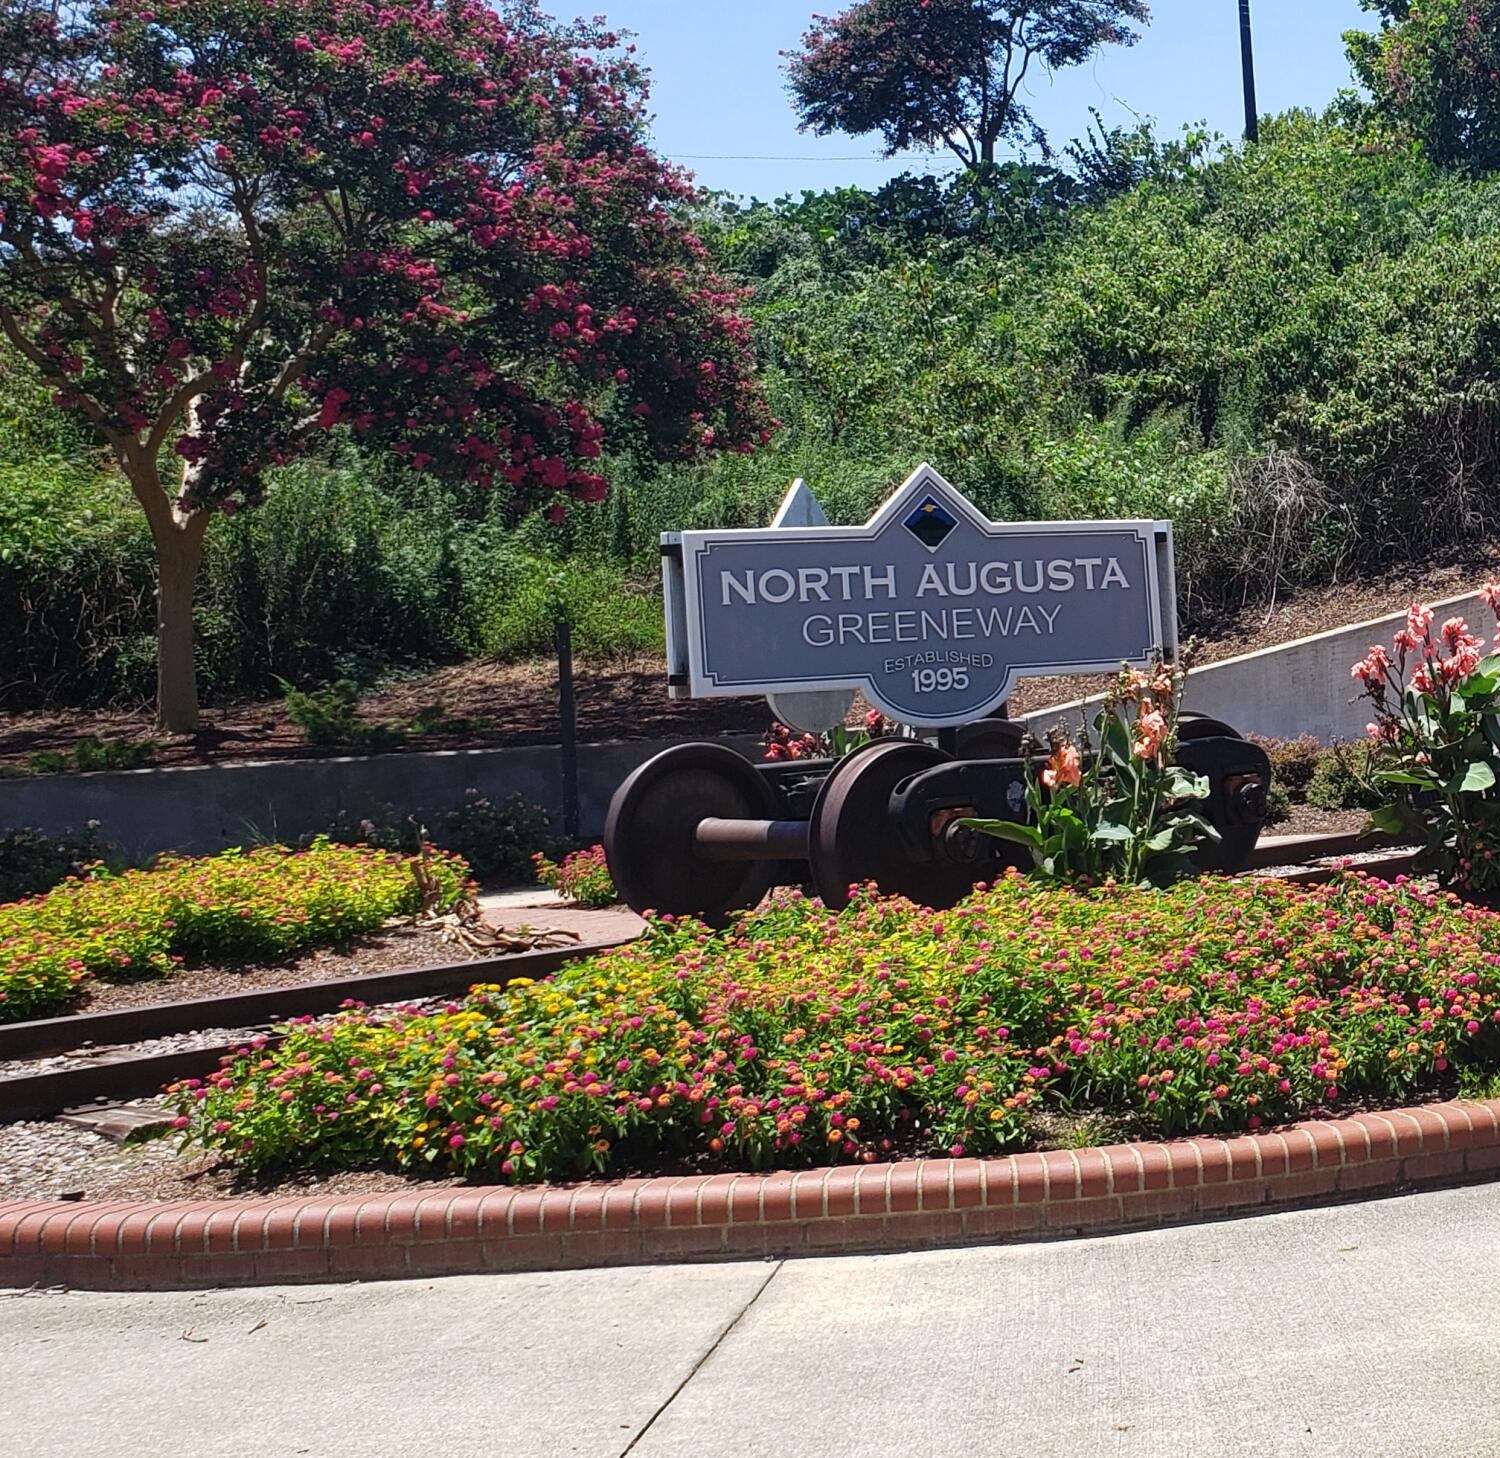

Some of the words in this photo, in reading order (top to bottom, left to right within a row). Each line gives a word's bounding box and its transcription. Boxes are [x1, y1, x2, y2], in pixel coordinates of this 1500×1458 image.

[720, 564, 897, 606] NORTH
[915, 556, 1131, 599] AUGUSTA
[801, 603, 1063, 647] GREENEWAY
[884, 649, 994, 674] ESTABLISHED
[911, 665, 970, 694] 1995
